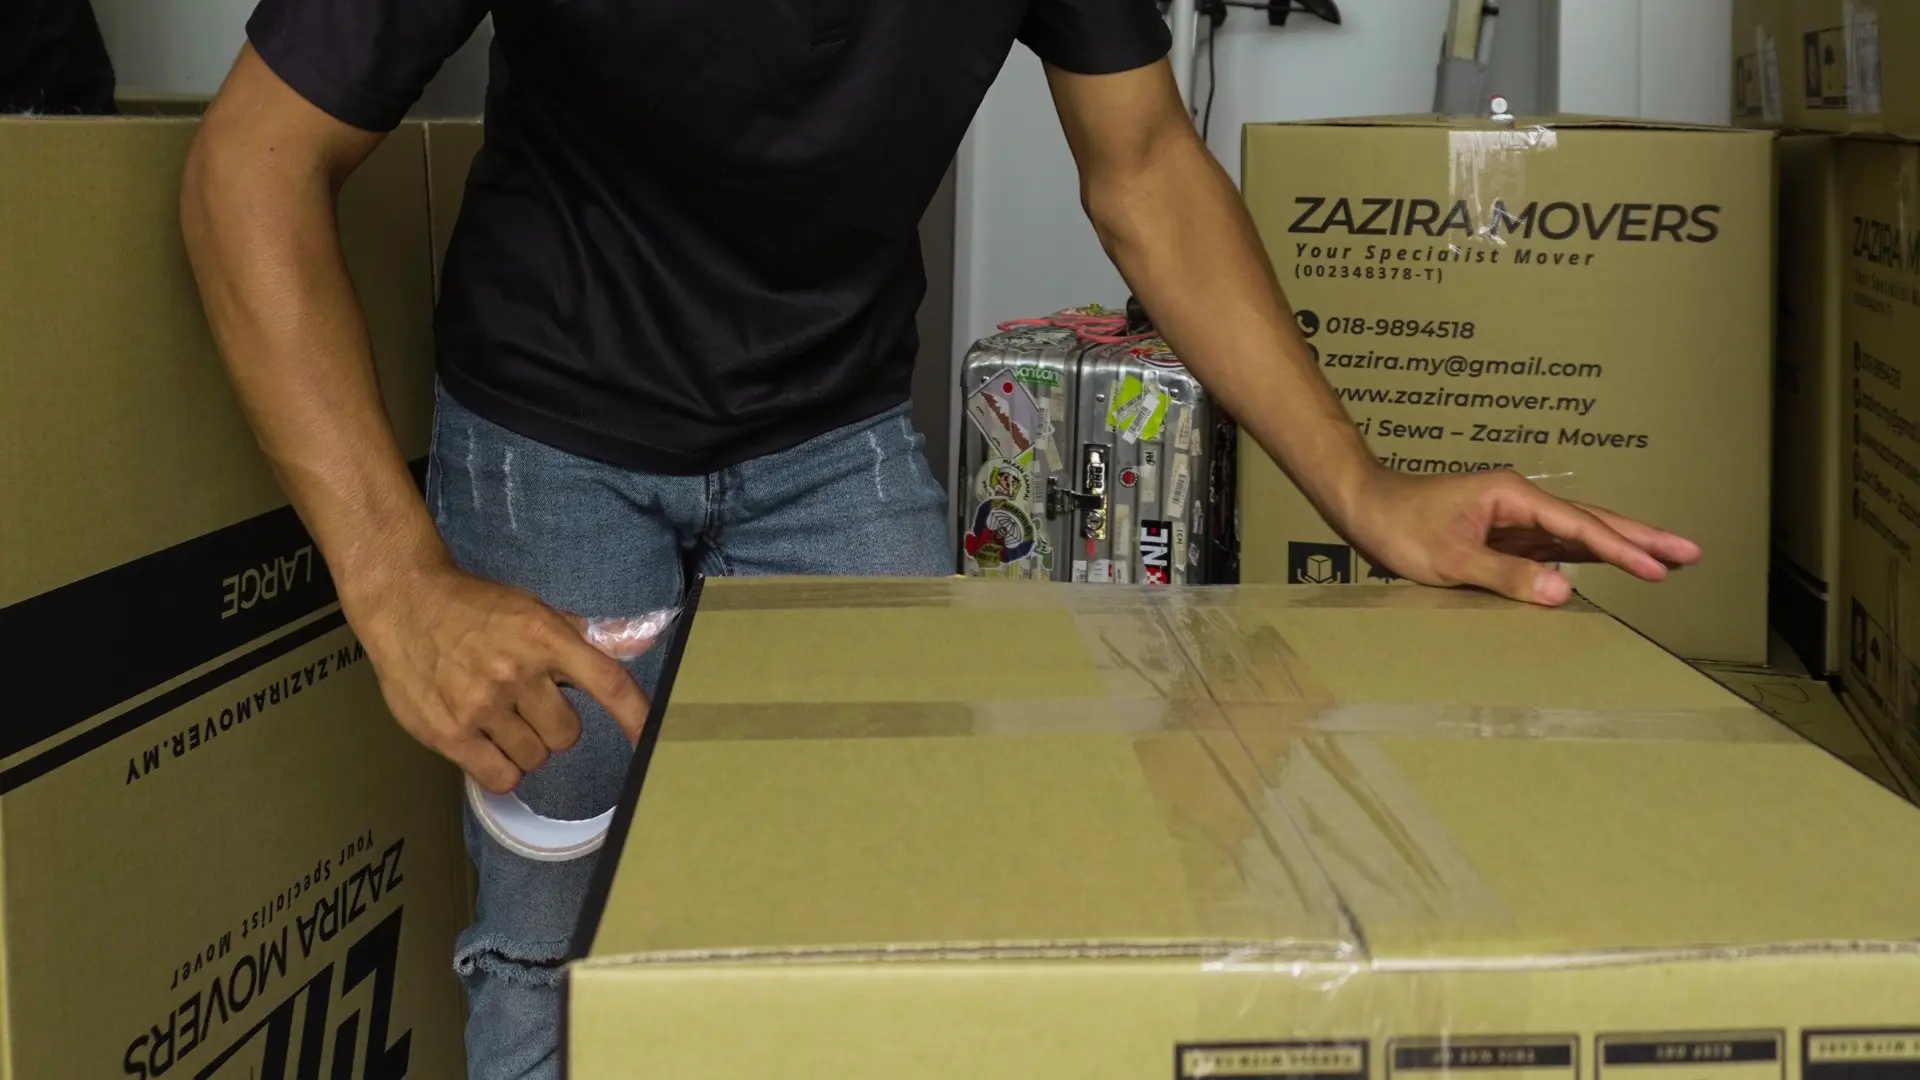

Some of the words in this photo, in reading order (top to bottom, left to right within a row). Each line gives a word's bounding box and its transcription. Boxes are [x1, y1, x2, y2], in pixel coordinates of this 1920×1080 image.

[1288, 197, 1474, 237] ZAZIRA
[1490, 200, 1721, 243] MOVERS
[1295, 264, 1443, 284] (002348378-T)
[1296, 243, 1352, 259] Your
[1365, 244, 1500, 264] Specialist
[1513, 249, 1594, 265] Mover
[1326, 317, 1475, 339] 018-9894518
[1324, 351, 1602, 378] zazira.my@gmail.com
[1378, 419, 1444, 440] Sewa
[1470, 424, 1549, 445] Zazira
[1557, 427, 1649, 449] Movers
[220, 545, 313, 620] LARGE
[339, 830, 373, 867] Your
[242, 860, 331, 940] Specialist
[296, 837, 405, 958] ZAZIRA
[170, 931, 231, 991] Mover
[122, 926, 288, 1080] MOVERS
